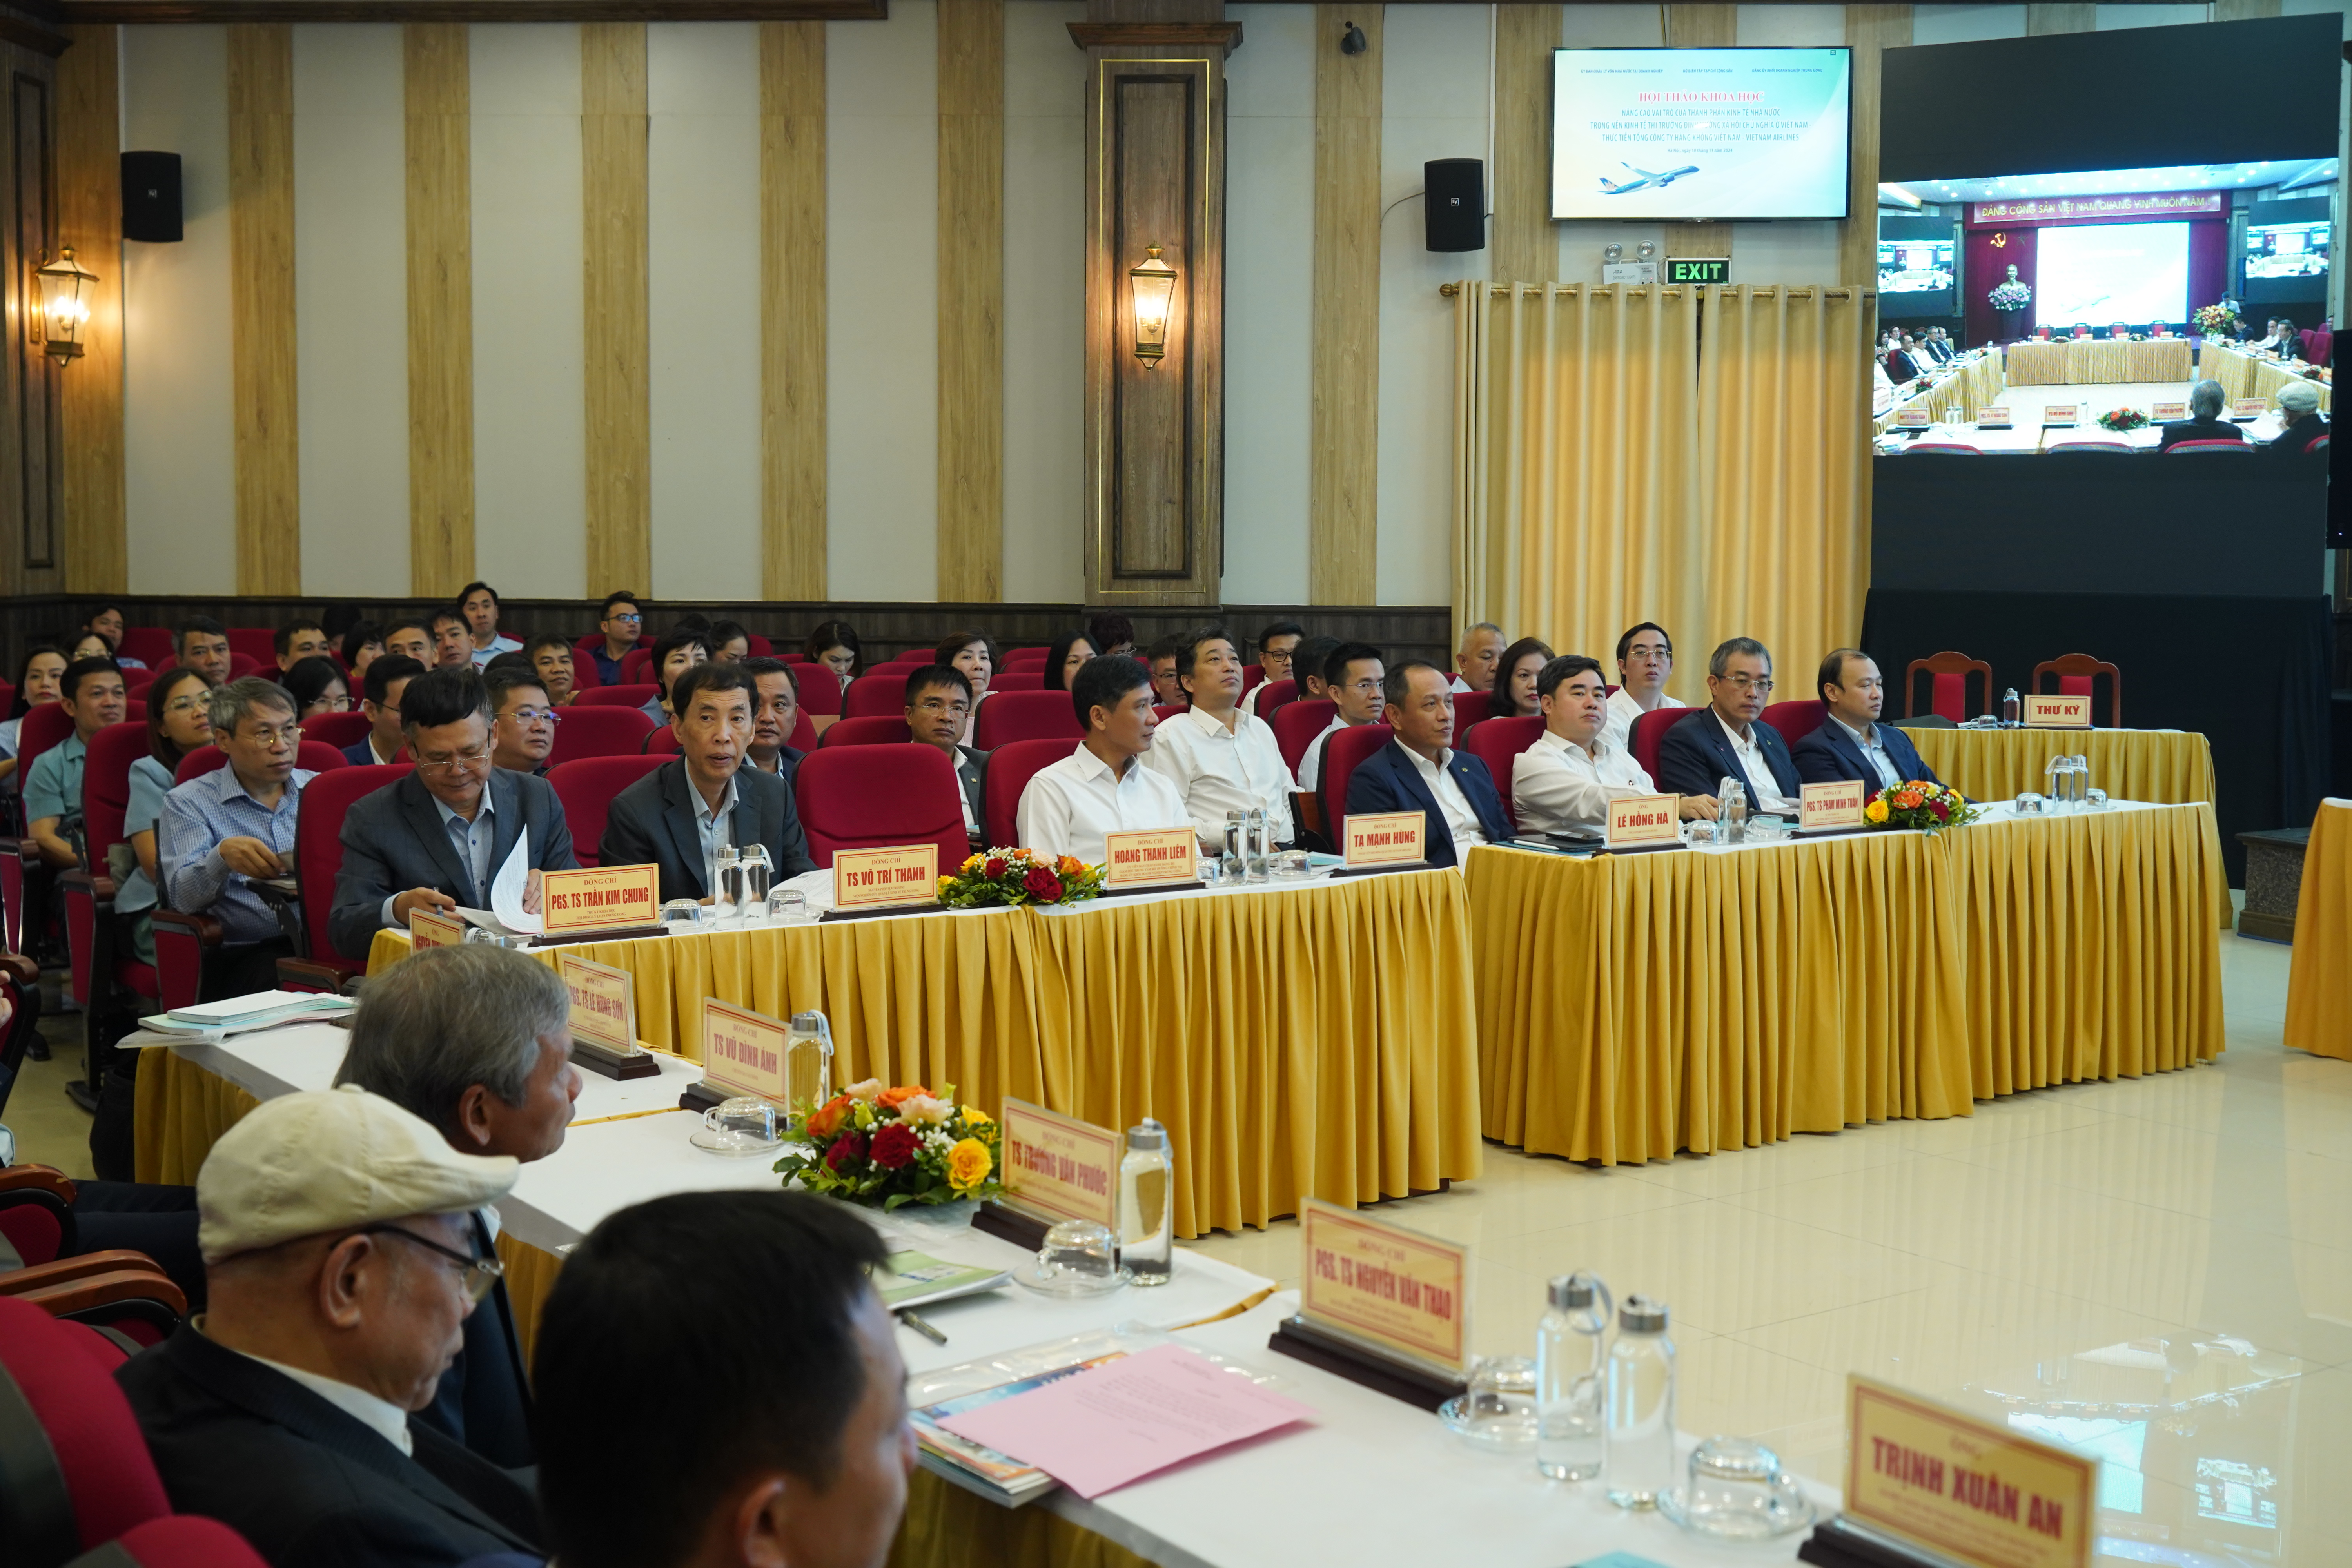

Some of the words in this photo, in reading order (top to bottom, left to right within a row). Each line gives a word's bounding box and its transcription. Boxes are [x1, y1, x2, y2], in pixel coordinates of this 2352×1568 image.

[1639, 91, 1660, 104] HỘI
[1664, 89, 1697, 102] THẢO
[1701, 92, 1735, 101] KHOA
[1738, 92, 1764, 103] HỌC
[1622, 108, 1638, 116] NÂNG
[1663, 108, 1673, 116] TRÒ
[1675, 107, 1686, 116] CỦA
[1688, 108, 1708, 116] THÀNH
[1743, 107, 1749, 116] TẾ
[1751, 107, 1763, 116] NHÀ
[1764, 107, 1780, 116] NƯỚC
[1640, 120, 1647, 129] TẾ
[1648, 122, 1657, 131] THỊ
[1722, 120, 1729, 129] XÃ
[1731, 120, 1741, 130] HỘI
[1743, 120, 1754, 128] CHỦ
[1756, 120, 1774, 128] NGHĨA
[1781, 120, 1793, 130] VIỆT
[1602, 134, 1617, 143] THỰC
[1650, 133, 1664, 141] CÔNG
[1714, 132, 1726, 143] VIỆT
[1982, 204, 2007, 217] ĐẢNG
[2009, 204, 2036, 217] CỘNG
[2038, 201, 2055, 214] SẢN
[2058, 202, 2074, 215] VIỆT
[2076, 203, 2097, 212] NAM
[2100, 200, 2131, 211] QUANG
[2134, 200, 2154, 209] VINH
[2156, 197, 2182, 208] MUÔN
[2184, 196, 2205, 207] NĂM
[1675, 263, 1722, 280] EXIT
[2036, 704, 2062, 715] THƯ
[2065, 705, 2080, 715] KÝ
[1807, 801, 1816, 812] PGS.
[1817, 800, 1822, 811] TS
[1823, 799, 1835, 812] PHẠM
[1836, 799, 1846, 809] MINH
[1848, 794, 1858, 808] TUẤN
[1618, 814, 1626, 828] LÊ
[1630, 811, 1653, 827] HỒNG
[1657, 811, 1668, 824] HÀ
[1354, 835, 1364, 849] TẠ
[1367, 833, 1390, 848] MẠNH
[1393, 829, 1415, 844] HÙNG
[1115, 848, 1140, 864] HOÀNG
[1143, 847, 1167, 861] THANH
[1170, 844, 1186, 859] LIÊM
[604, 876, 617, 884] CHÍ
[847, 872, 858, 887] TS
[861, 869, 873, 885] VÕ
[877, 867, 891, 884] TRÍ
[895, 866, 925, 882] THÀNH
[552, 894, 569, 910] PGS.
[571, 893, 581, 908] TS
[583, 886, 603, 907] TRẦN
[606, 889, 620, 905] KIM
[622, 887, 649, 904] CHUNG
[569, 985, 581, 1007] PGS.
[581, 989, 589, 1009] TS
[590, 990, 596, 1011] LÊ
[596, 993, 611, 1017] HÙNG
[612, 998, 624, 1021] SƠN
[714, 1033, 723, 1056] TS
[726, 1036, 736, 1060] VŨ
[739, 1040, 758, 1068] ĐÌNH
[1012, 1140, 1021, 1165] TS
[1871, 1435, 1944, 1494] TRỊNH
[1952, 1465, 2020, 1523] XUÂN
[2028, 1494, 2063, 1541] AN
